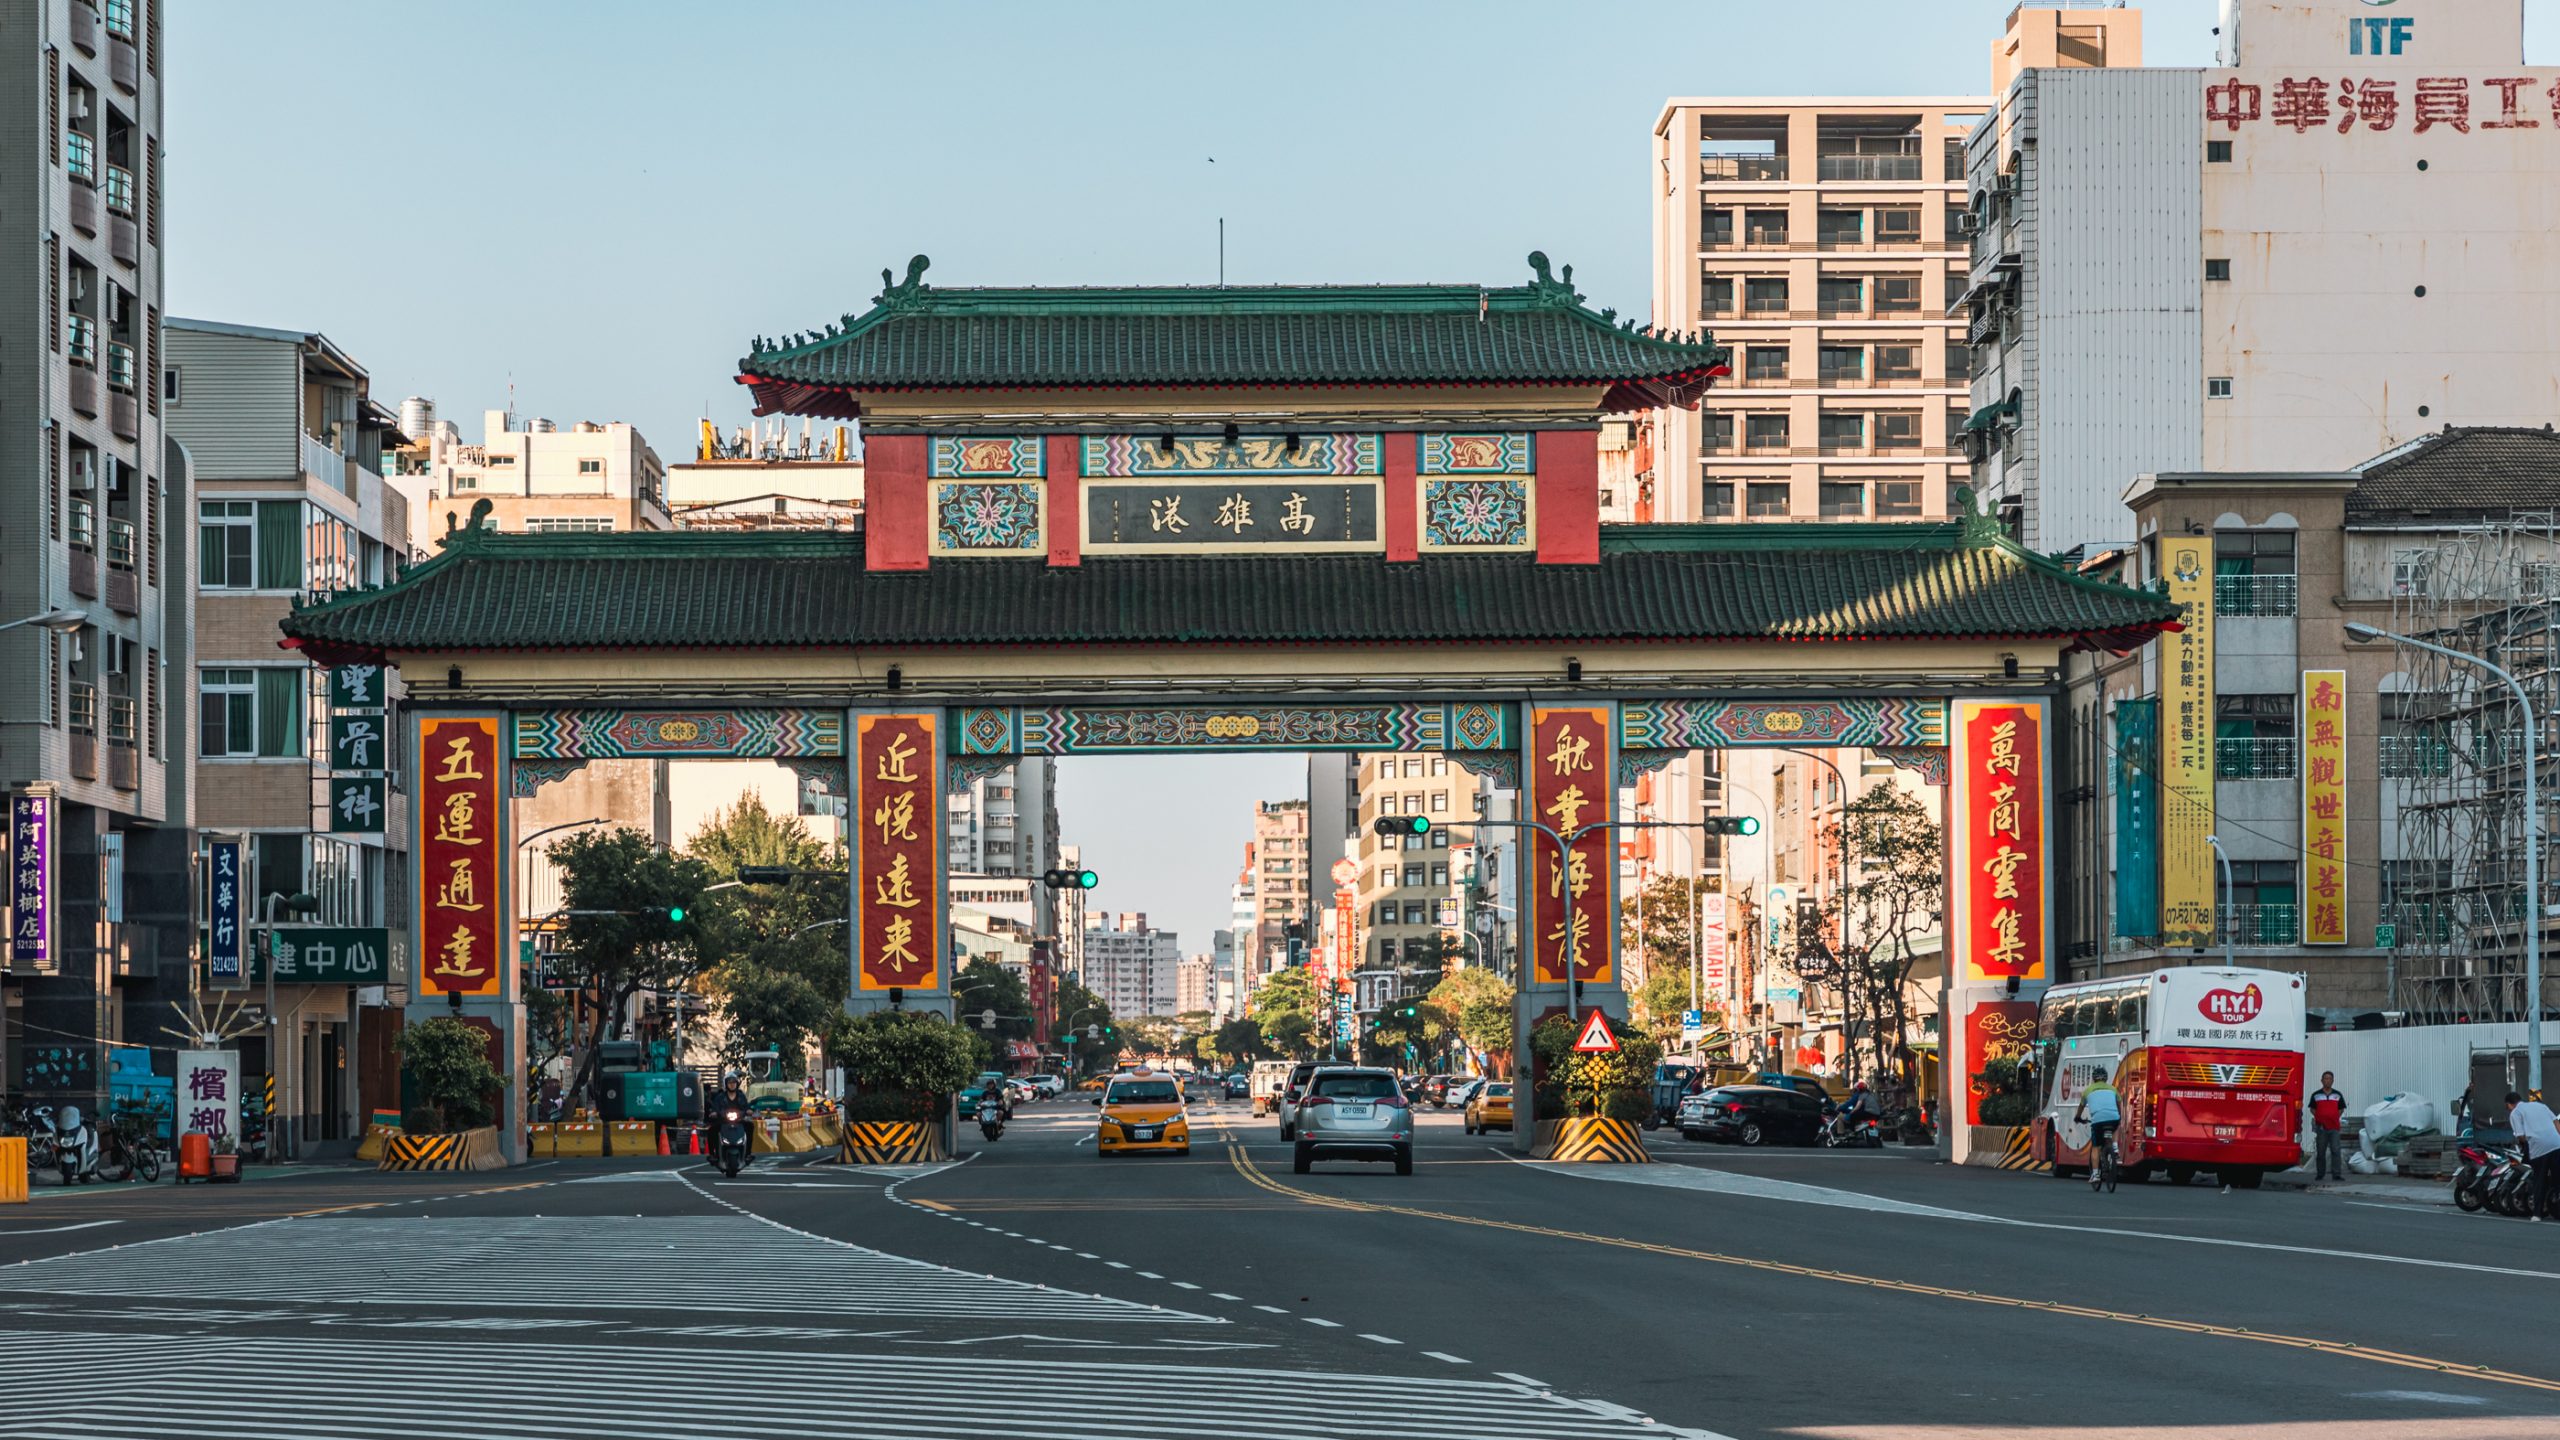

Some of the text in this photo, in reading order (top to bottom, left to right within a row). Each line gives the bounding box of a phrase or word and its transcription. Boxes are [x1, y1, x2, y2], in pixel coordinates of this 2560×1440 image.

[2349, 18, 2414, 55] ITF
[2206, 76, 2560, 135] 中華海員工
[1150, 491, 1316, 535] 高雄港
[1983, 720, 2028, 964] 萬商雲集
[2309, 680, 2343, 936] 南無觀世音菩薩
[434, 736, 485, 977] 五運通達
[874, 732, 921, 974] 近悅遠來
[217, 848, 234, 946] 文華行
[1707, 922, 1723, 990] YAMAHA
[2177, 1028, 2284, 1042] 環遊國際旅行社
[2222, 1014, 2244, 1022] TOUR
[189, 1066, 227, 1141] 檳榔
